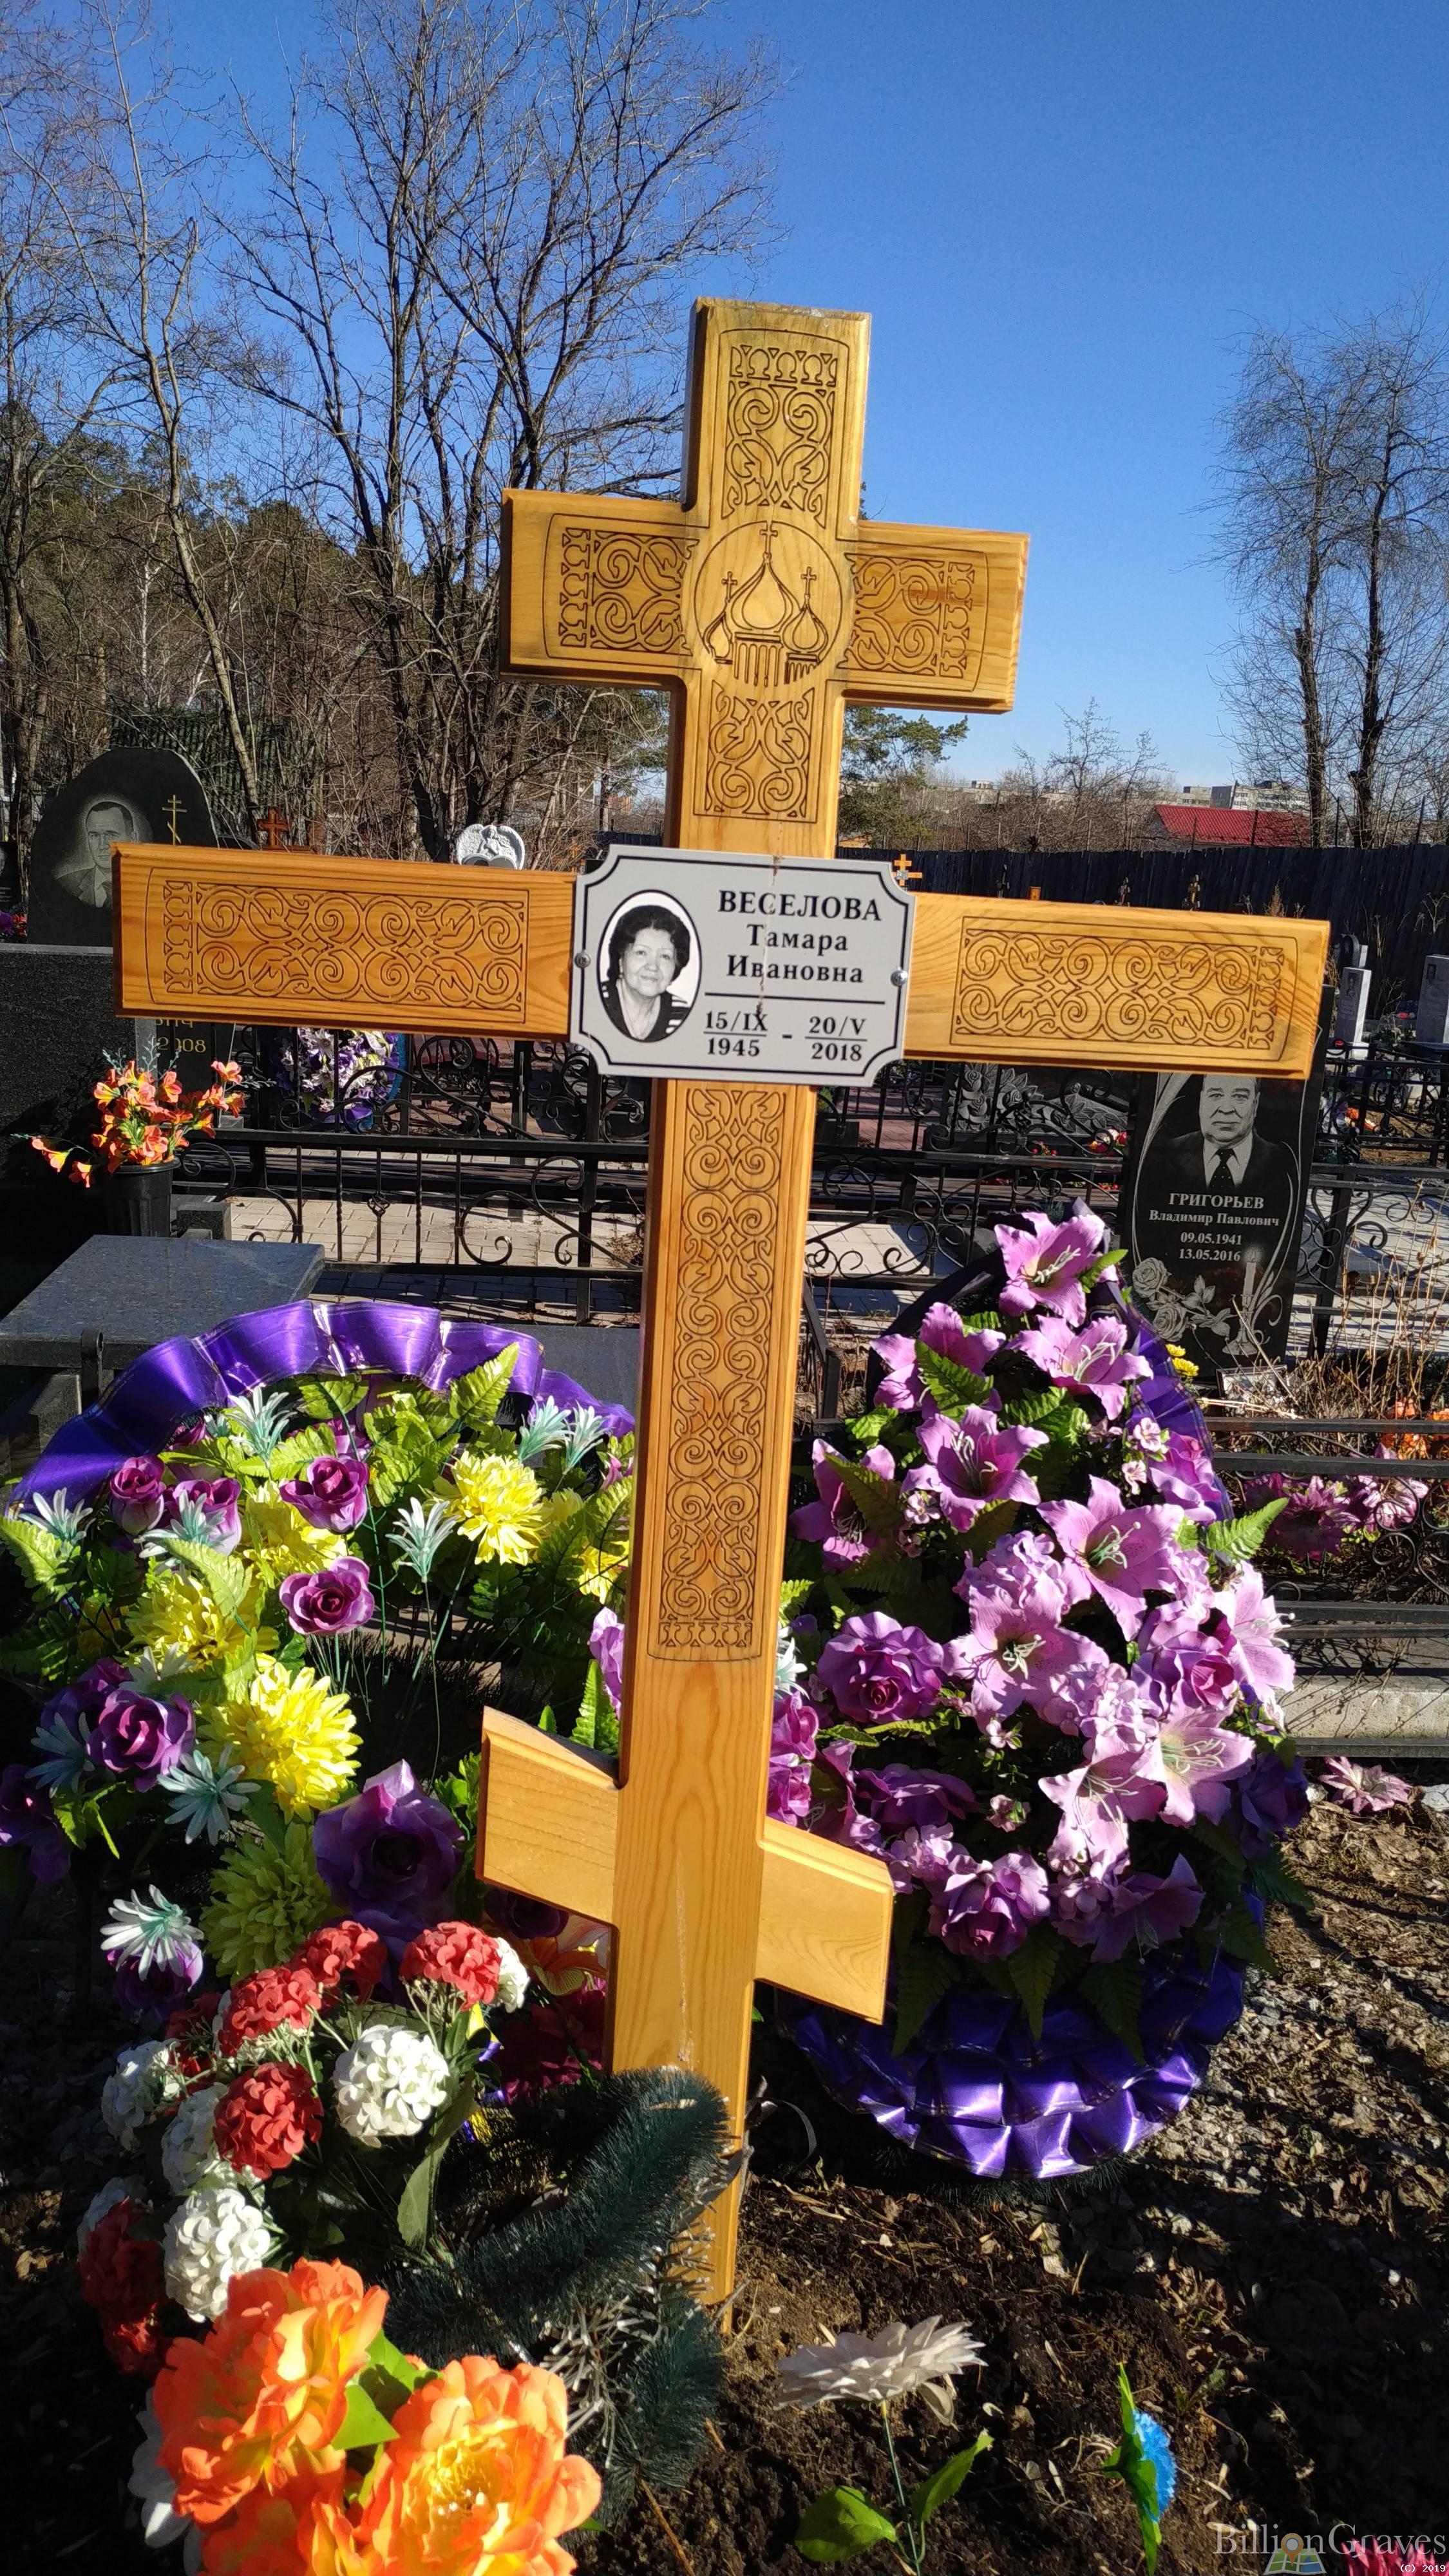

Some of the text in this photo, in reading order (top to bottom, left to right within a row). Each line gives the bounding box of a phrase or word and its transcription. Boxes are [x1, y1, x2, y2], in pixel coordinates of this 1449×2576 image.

[718, 890, 882, 921] ВЕСЕЛОВА
[747, 924, 848, 956] Тамара
[726, 955, 863, 983] Ивановна
[705, 1011, 768, 1030] 15/IX
[809, 1016, 866, 1036] 20/V
[707, 1037, 862, 1061] 1945 2018
[1169, 1193, 1264, 1209] ГРИГОРЬЕВ
[1149, 1210, 1280, 1226] Владимир Павлович
[1180, 1231, 1242, 1245] 09.05.1941
[1179, 1248, 1241, 1262] 13.05.2016
